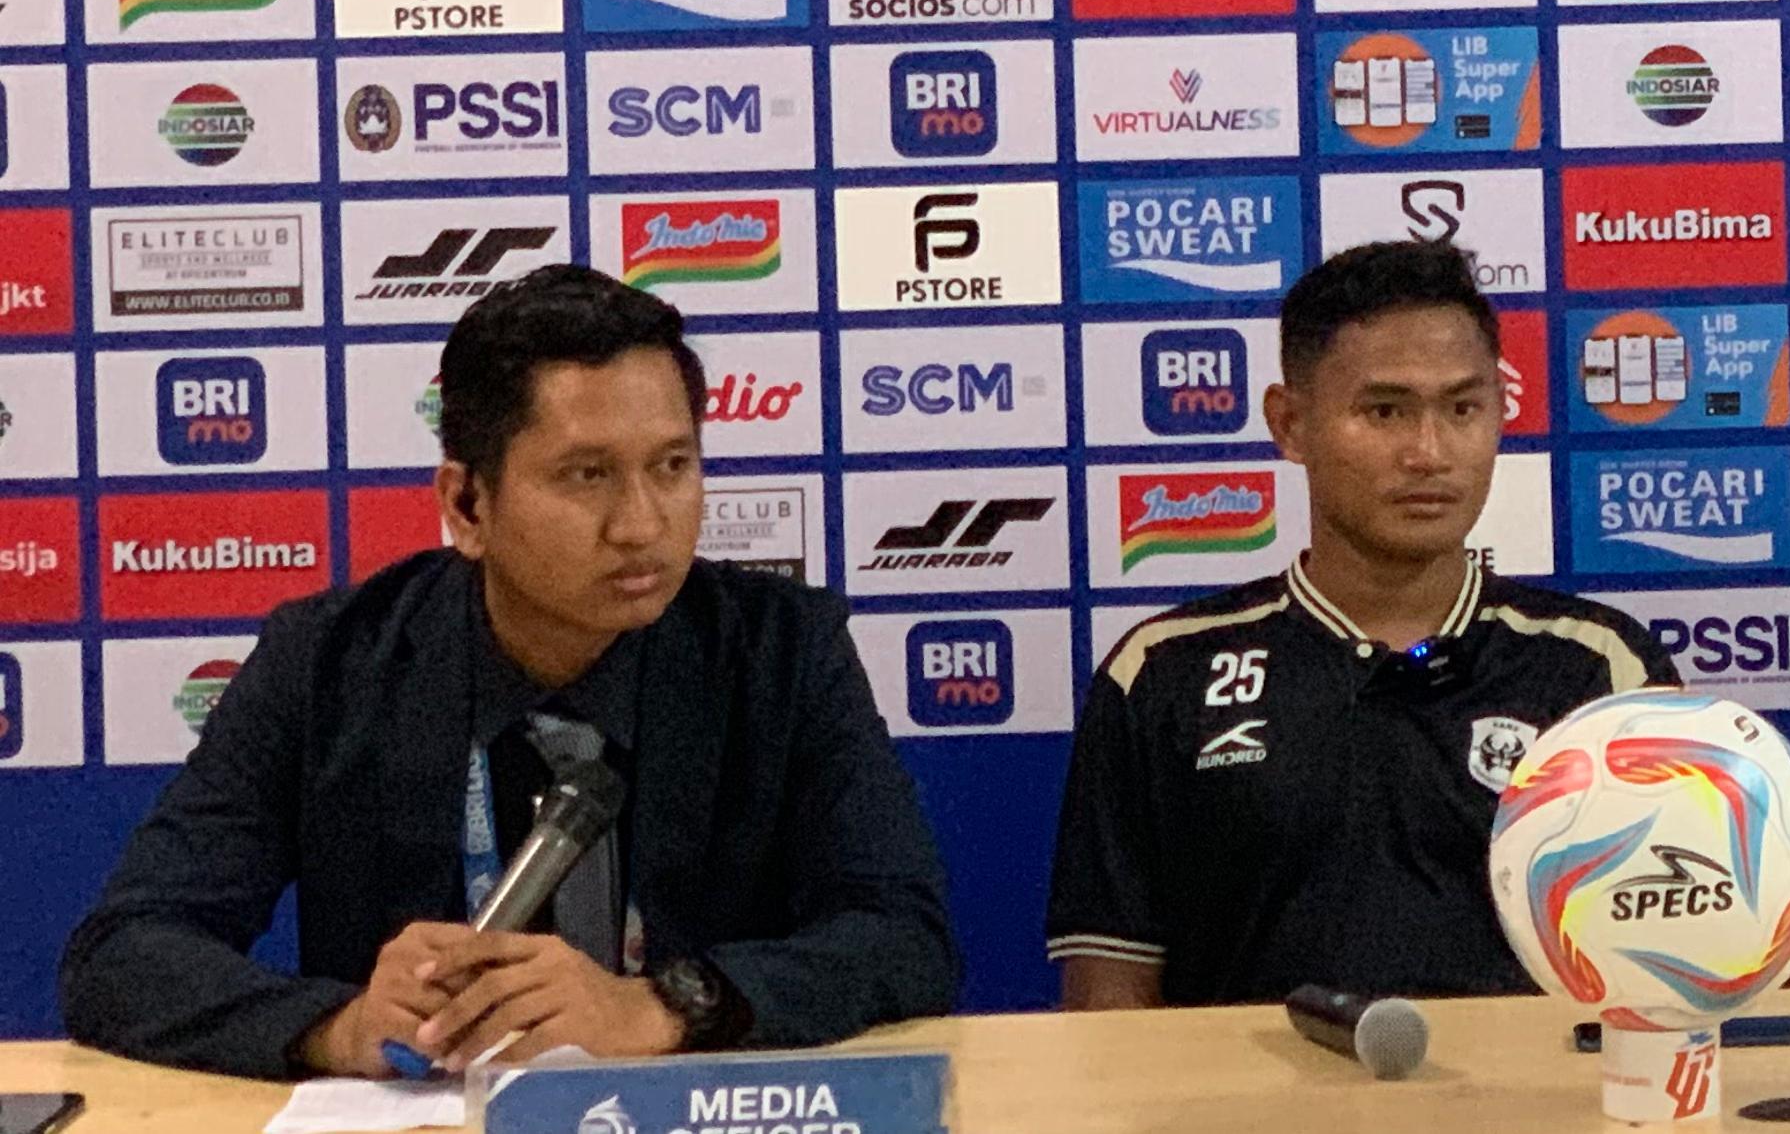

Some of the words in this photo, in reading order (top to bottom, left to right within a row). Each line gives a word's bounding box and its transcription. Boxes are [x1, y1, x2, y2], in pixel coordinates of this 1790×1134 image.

[394, 3, 502, 30] PSTORE
[1450, 37, 1486, 56] LIB
[1454, 60, 1521, 82] Super
[904, 73, 979, 110] BRI
[1456, 79, 1503, 100] App
[158, 115, 253, 134] INDOSIAR
[412, 81, 558, 140] PSSI
[607, 84, 762, 137] SCM
[1092, 109, 1280, 133] VIRTUALNESS
[1105, 196, 1273, 227] POCARI
[1574, 208, 1771, 243] KukuBima
[121, 227, 289, 249] ELITECLUB
[1107, 227, 1259, 257] SWEAT
[896, 275, 1003, 302] PSTORE
[1701, 314, 1736, 333] LIB
[1704, 337, 1770, 359] Super
[1156, 350, 1230, 387] BRI
[1705, 356, 1752, 377] App
[173, 379, 249, 416] BRI
[704, 372, 803, 423] dio
[860, 362, 1013, 415] SCM
[1599, 468, 1765, 498] POCARI
[1600, 499, 1750, 530] SWEAT
[0, 540, 57, 580] sija
[113, 536, 315, 572] KukuBima
[921, 641, 995, 678] BRI
[1204, 649, 1269, 707] 25
[1610, 880, 1734, 922] SPECS
[688, 1083, 839, 1124] MEDIA
